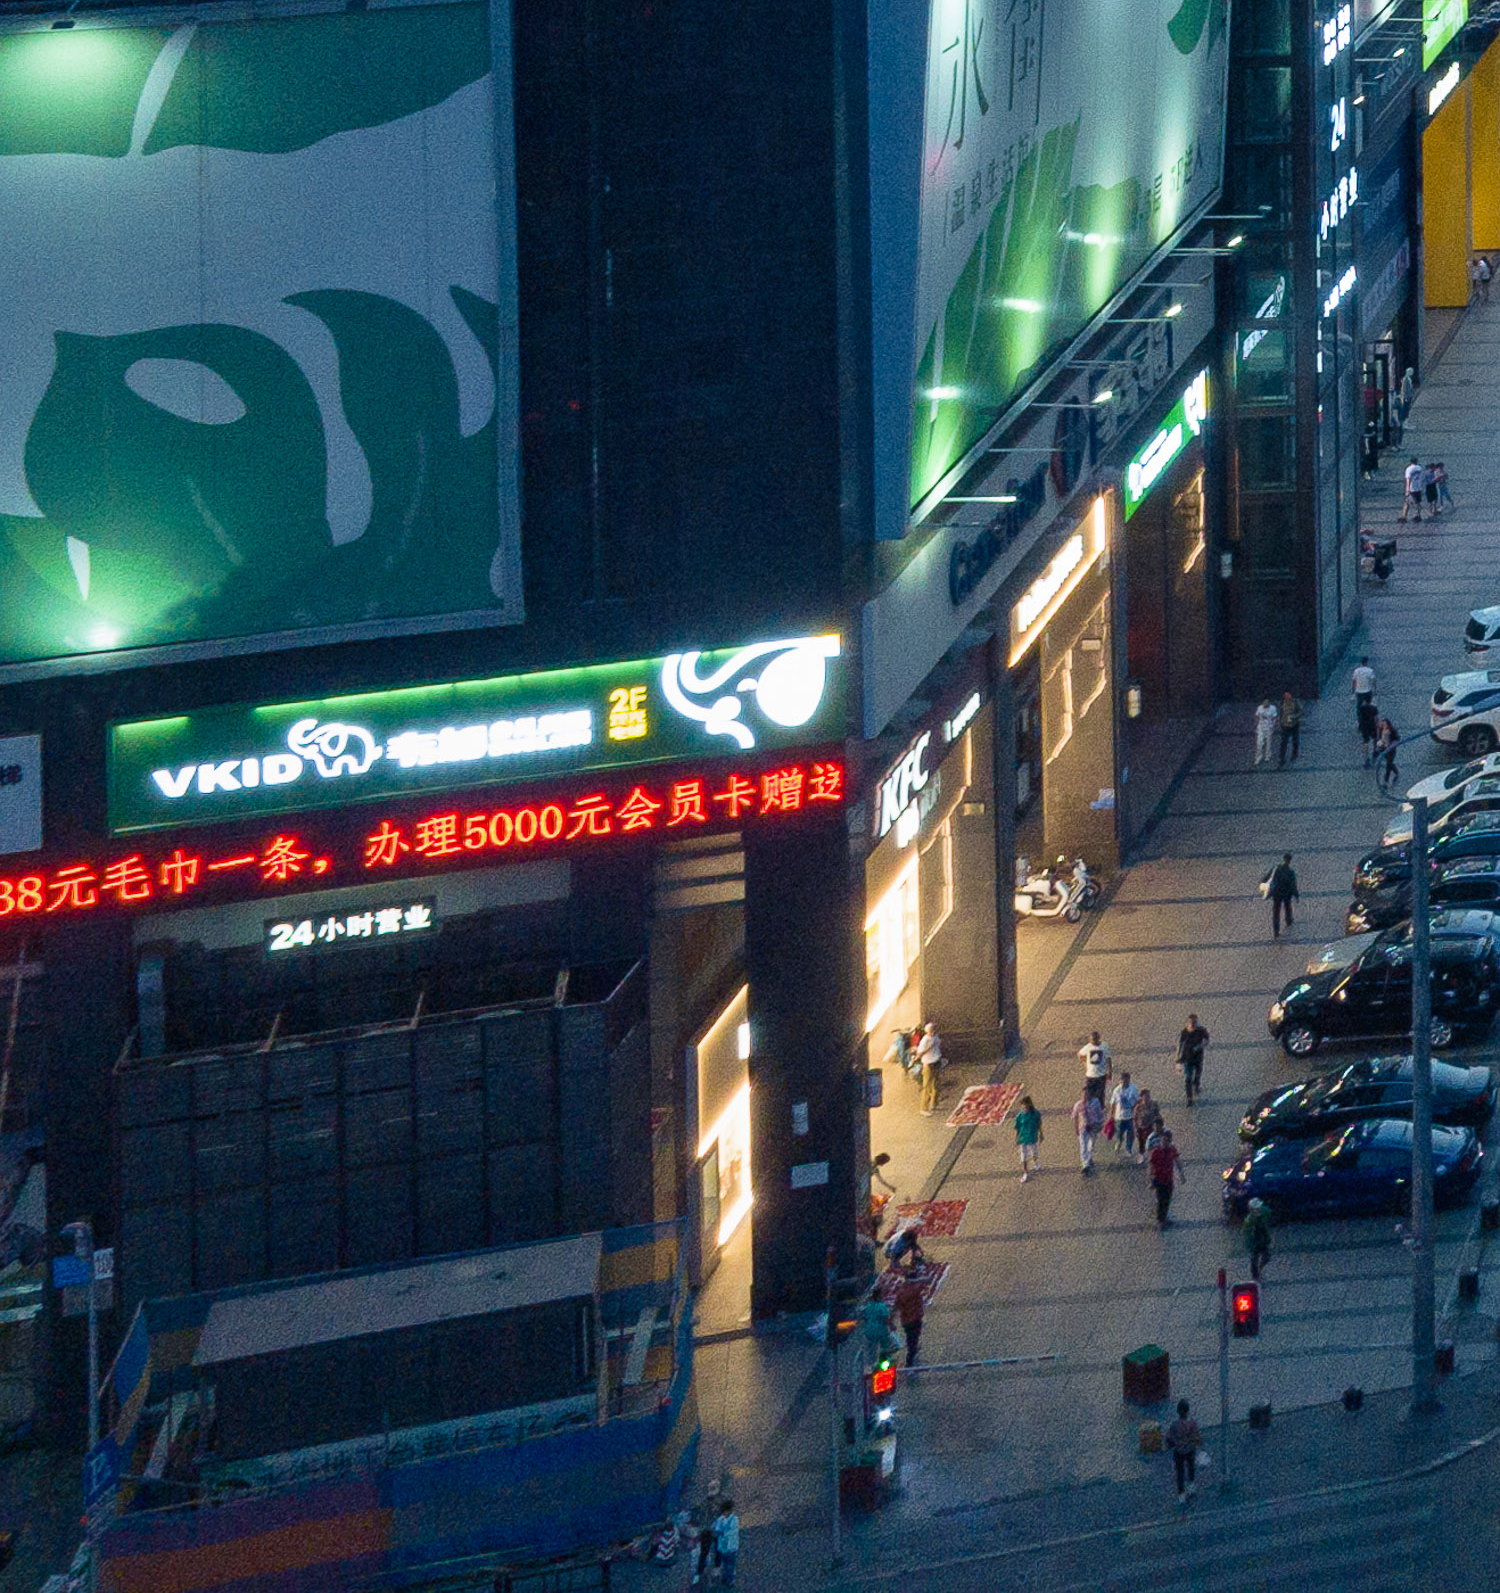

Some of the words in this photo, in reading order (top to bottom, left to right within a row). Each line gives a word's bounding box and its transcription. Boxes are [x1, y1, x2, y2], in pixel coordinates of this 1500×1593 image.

[609, 686, 648, 713] 2F
[152, 753, 303, 798] VKID
[879, 730, 931, 838] KFC
[269, 904, 431, 951] 24小时营业
